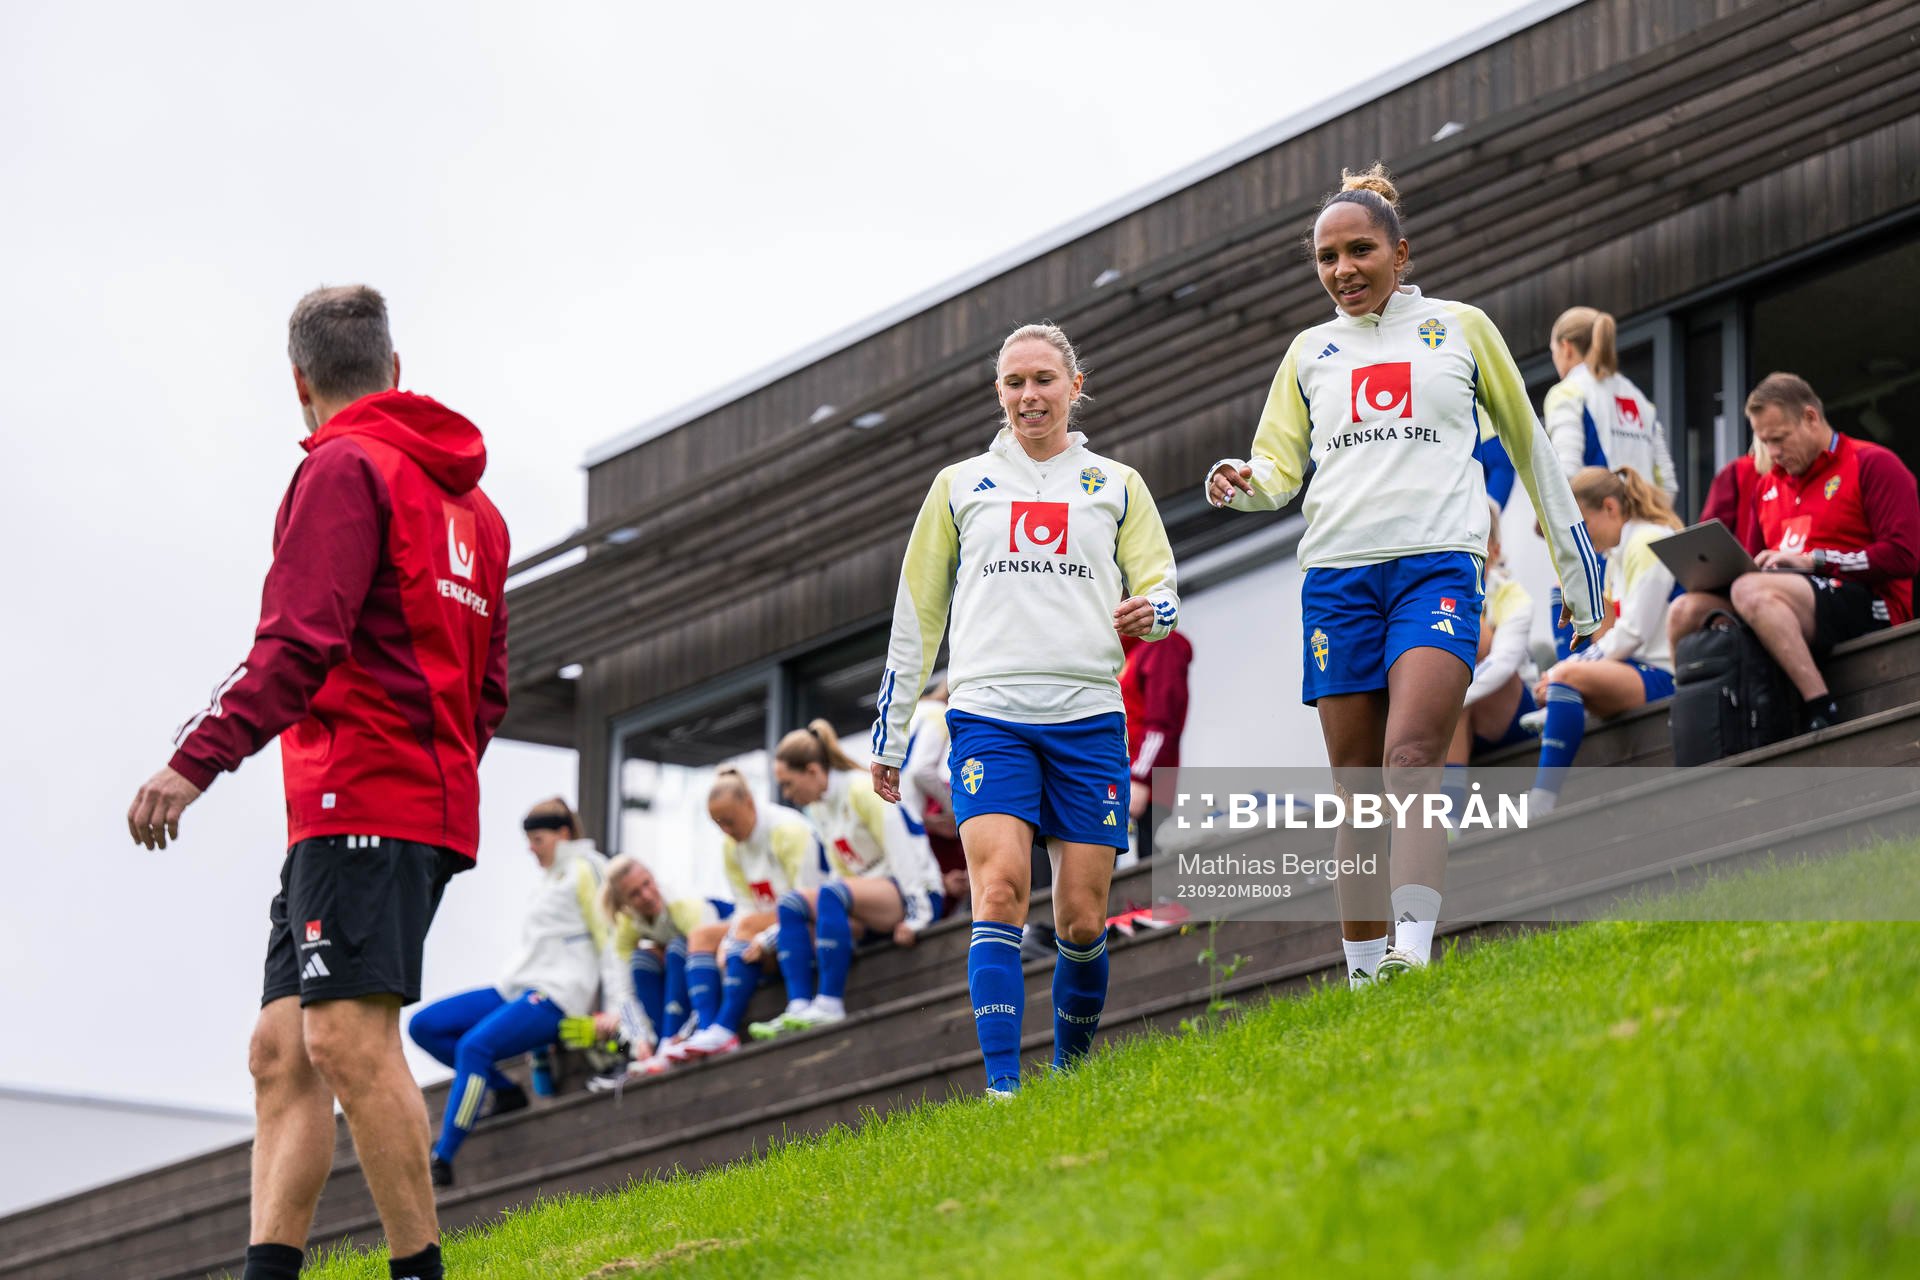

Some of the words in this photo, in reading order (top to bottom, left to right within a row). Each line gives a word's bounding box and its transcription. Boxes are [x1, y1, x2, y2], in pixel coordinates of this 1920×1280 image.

[1326, 427, 1398, 452] SVENSKA
[1403, 426, 1441, 443] SPEL
[983, 560, 1054, 578] SVENSKA
[1059, 562, 1095, 580] SPEL
